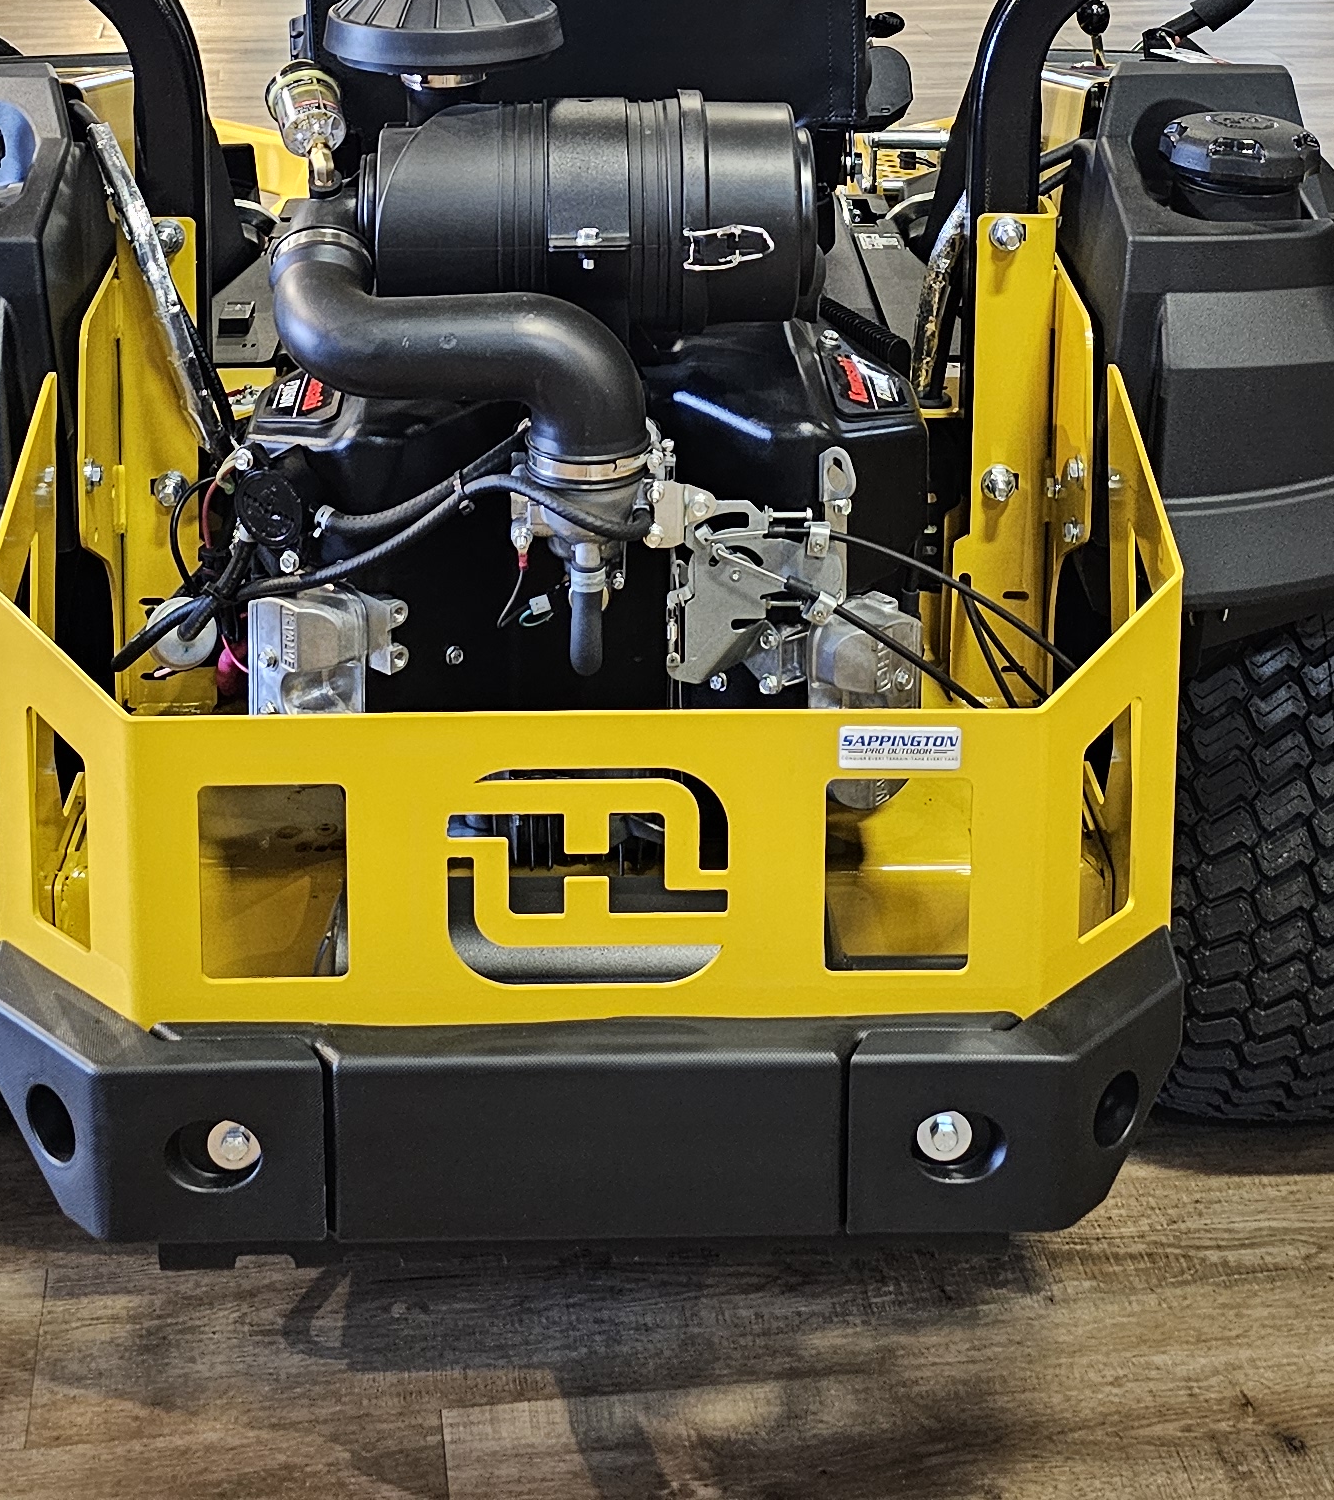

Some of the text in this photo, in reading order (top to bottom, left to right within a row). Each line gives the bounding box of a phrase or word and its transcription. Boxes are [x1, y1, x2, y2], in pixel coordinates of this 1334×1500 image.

[841, 734, 959, 747] SAPPINGTON
[864, 747, 933, 755] PRO OUTDOOR
